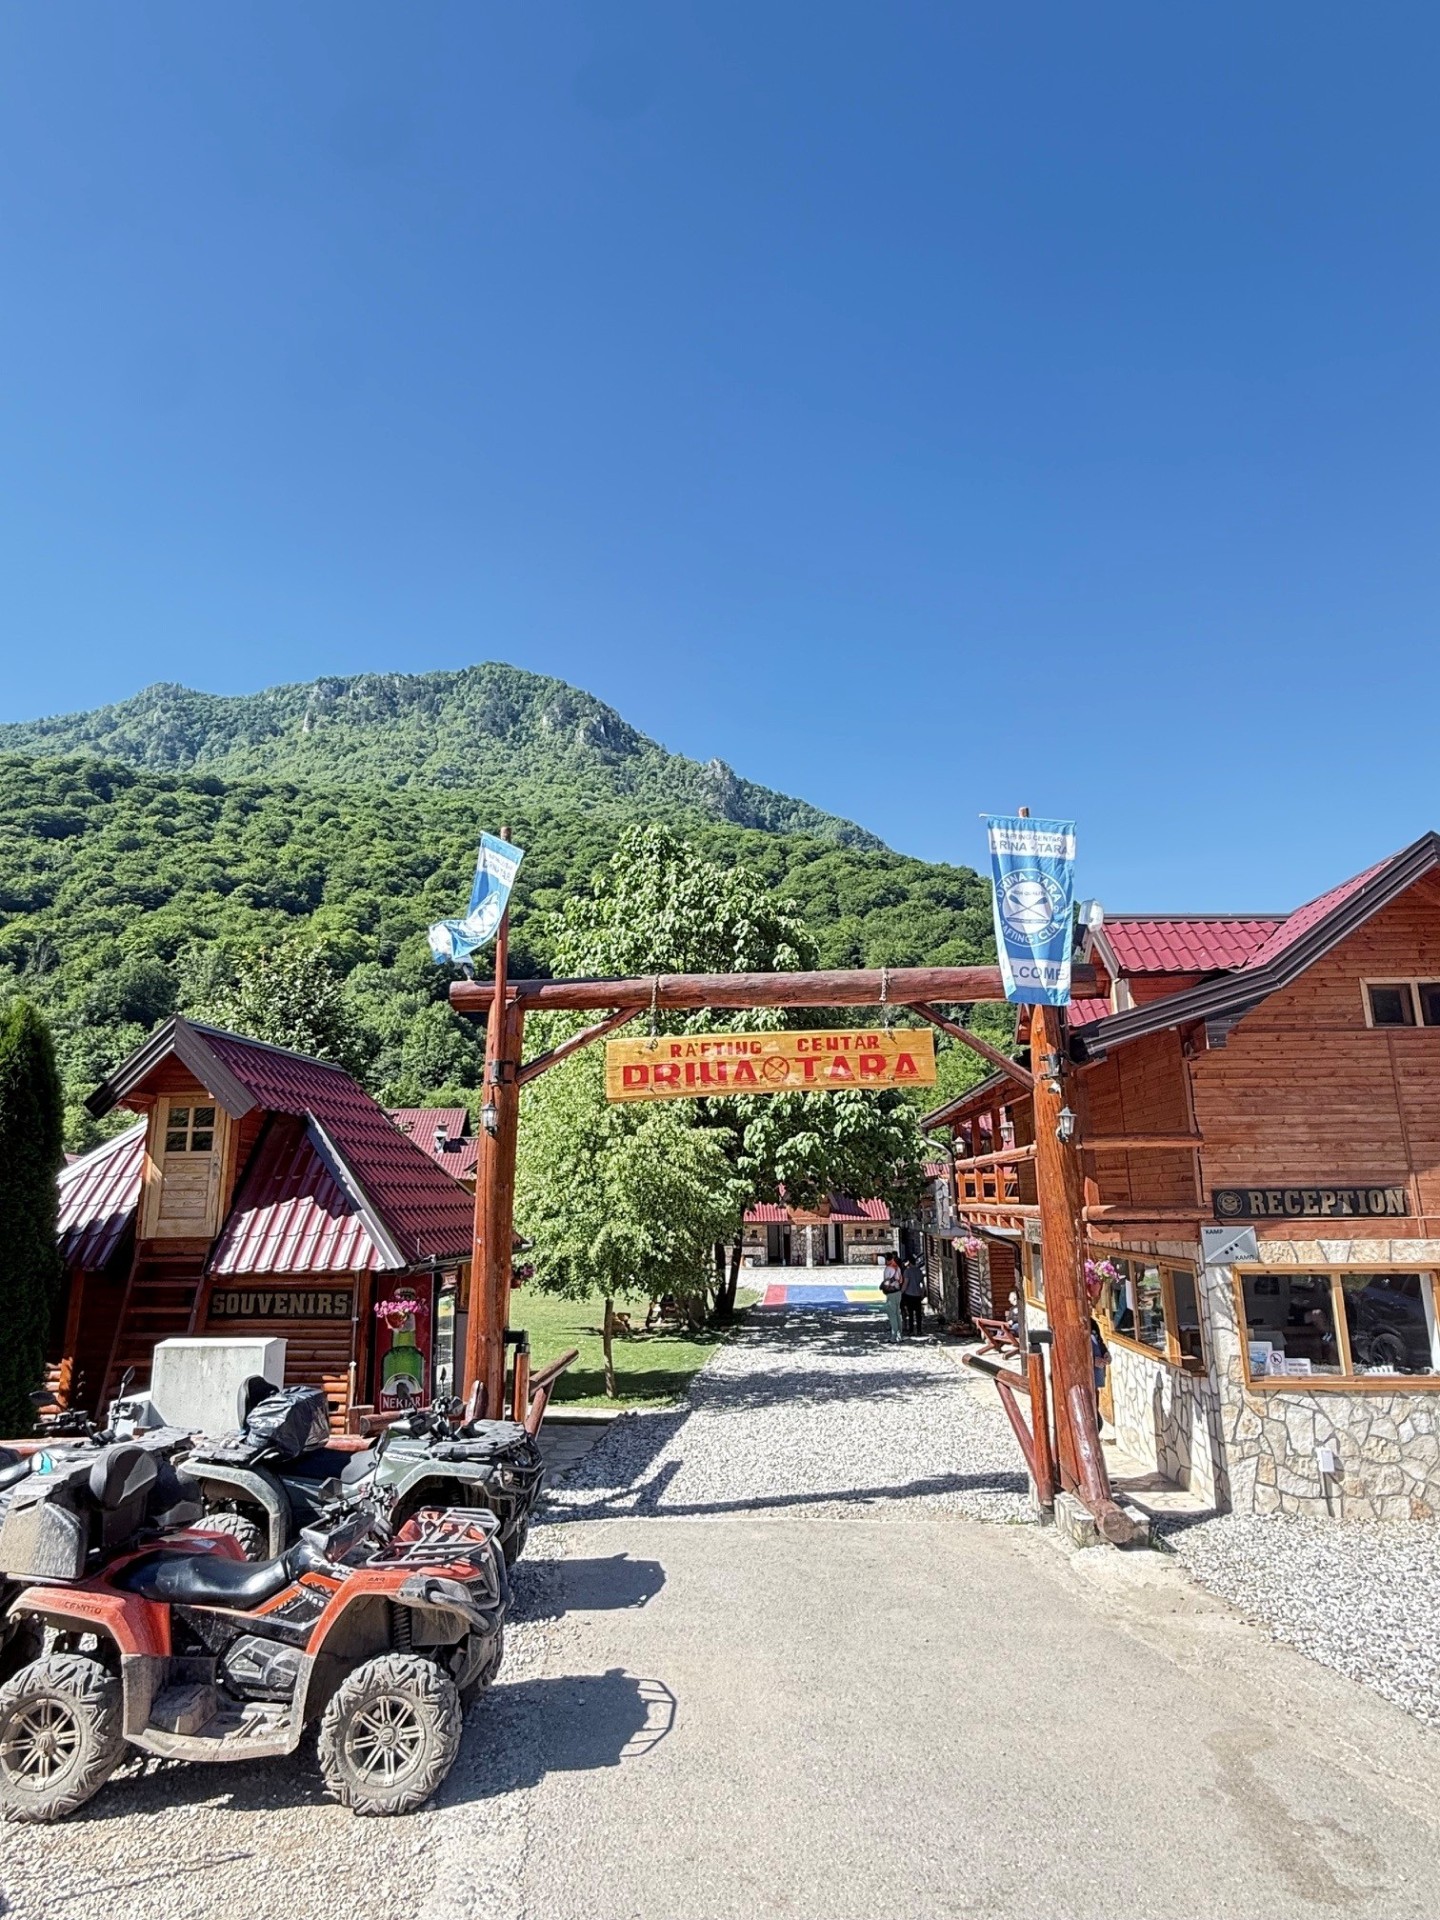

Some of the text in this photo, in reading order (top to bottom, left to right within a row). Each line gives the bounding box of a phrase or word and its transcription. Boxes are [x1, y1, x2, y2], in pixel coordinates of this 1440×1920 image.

[670, 1035, 880, 1058] RAFTING CENTAR
[794, 1053, 920, 1083] TARA
[1247, 1188, 1406, 1215] RECEPTION
[212, 1292, 349, 1315] SOUVENIRS
